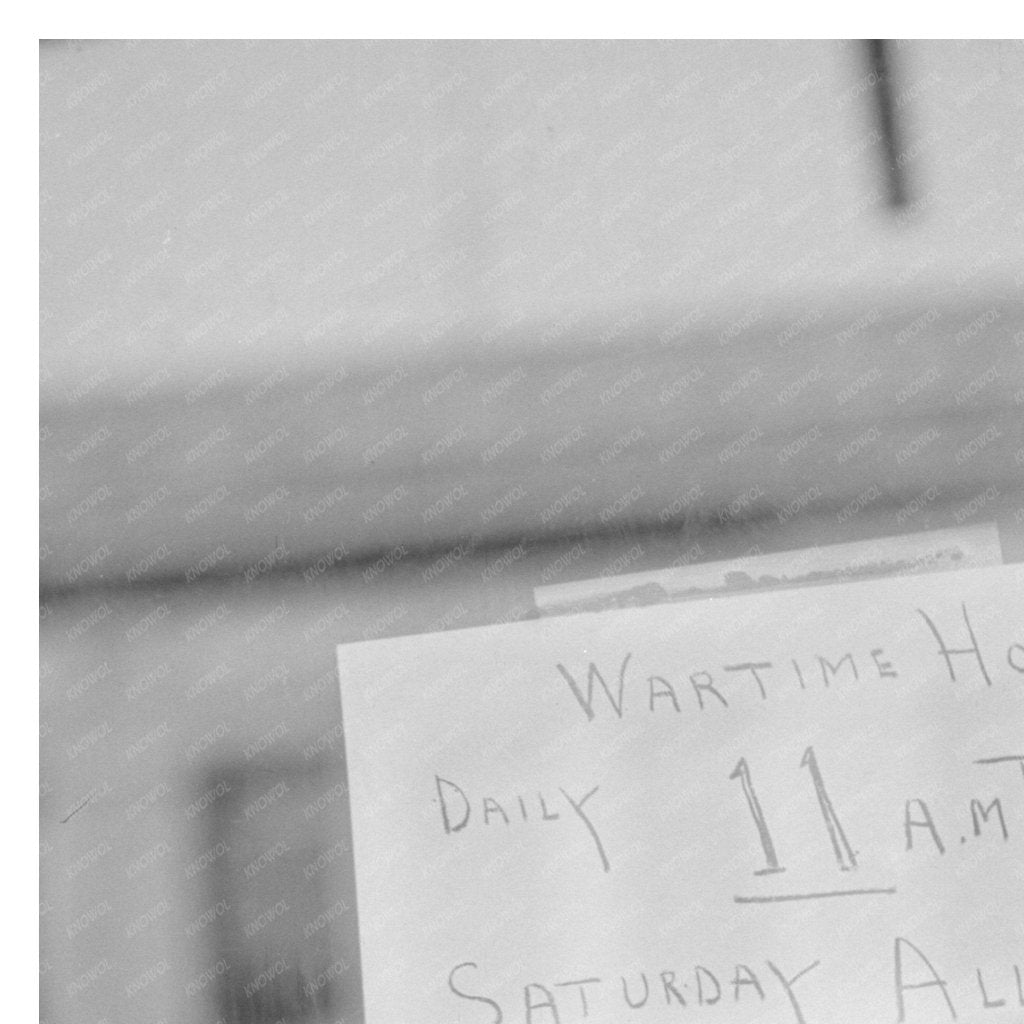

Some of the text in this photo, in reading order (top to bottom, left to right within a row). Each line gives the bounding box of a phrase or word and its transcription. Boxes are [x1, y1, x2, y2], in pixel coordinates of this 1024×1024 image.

[556, 652, 898, 722] WARTIME
[433, 774, 610, 873] DAILY
[728, 745, 859, 877] 11
